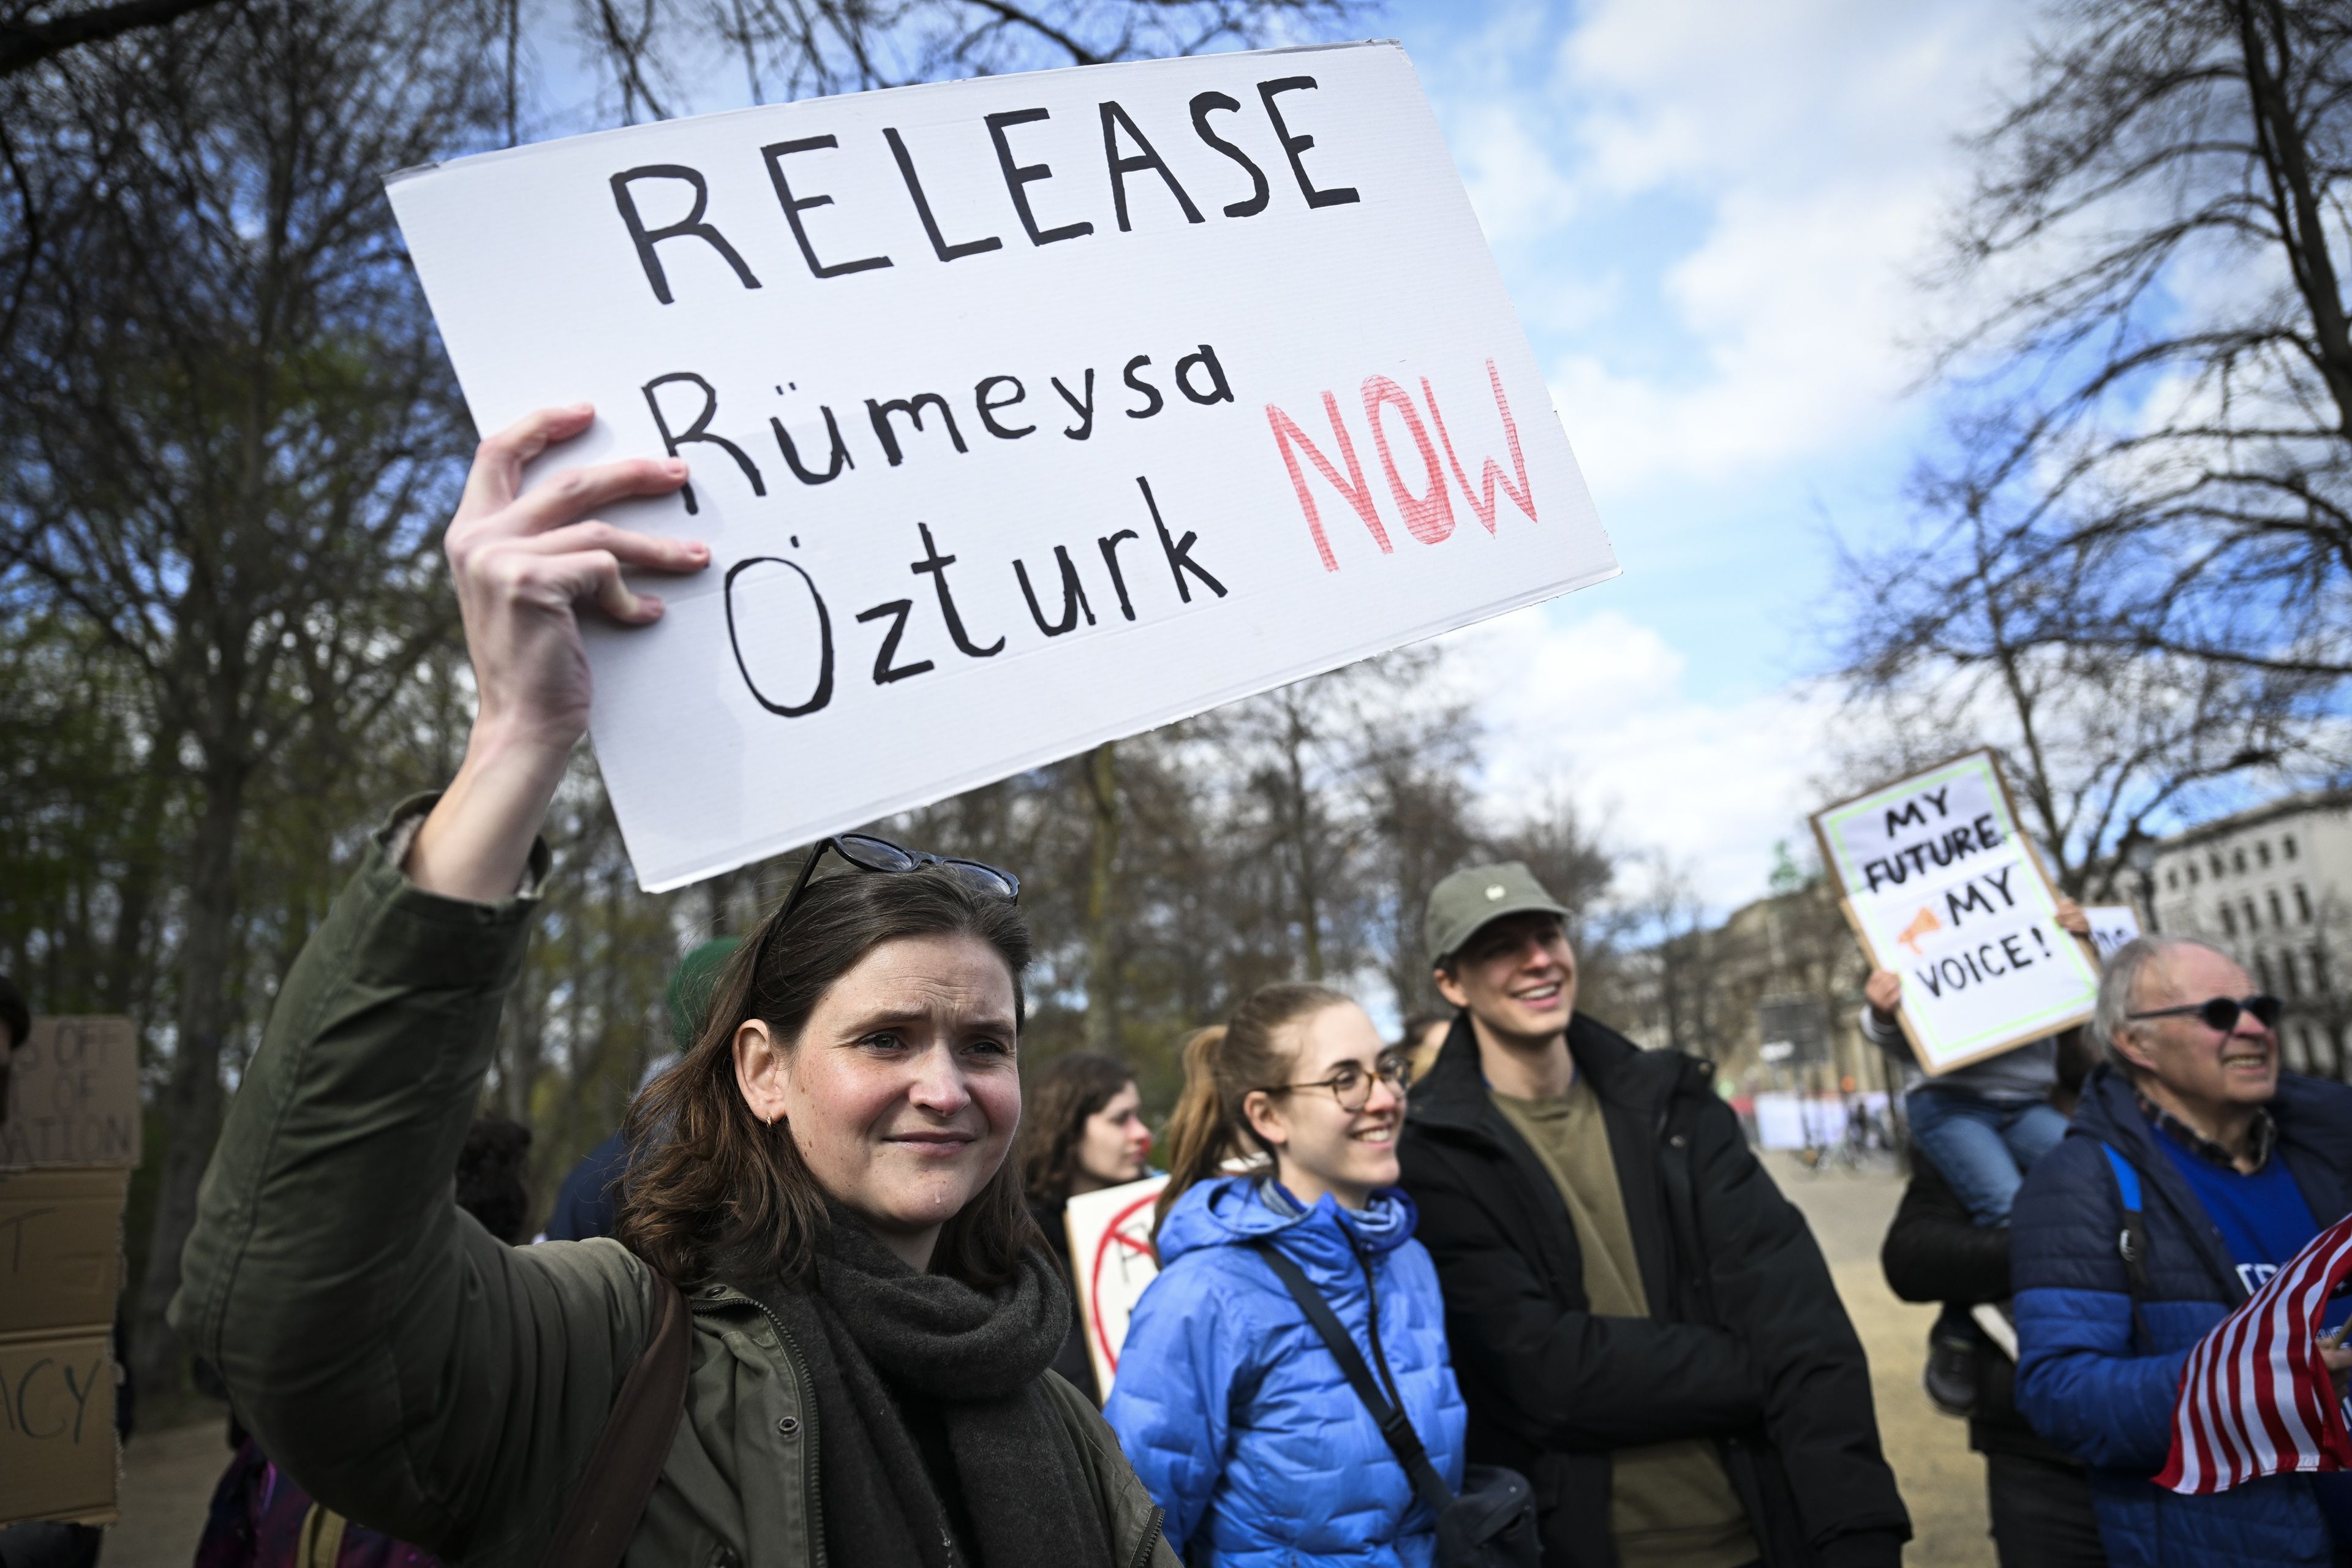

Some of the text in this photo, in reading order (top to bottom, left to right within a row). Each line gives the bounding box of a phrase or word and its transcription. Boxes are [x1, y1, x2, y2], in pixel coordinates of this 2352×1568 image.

[609, 75, 1360, 305] RELEASE
[641, 344, 1234, 515] Rümeysa
[1263, 357, 1538, 573] NOW
[1885, 787, 1948, 838] MY
[1863, 813, 2003, 894] FUTURE
[1945, 867, 2015, 926] MY
[1916, 927, 2051, 997] VOICE!
[0, 1114, 131, 1166] ATION
